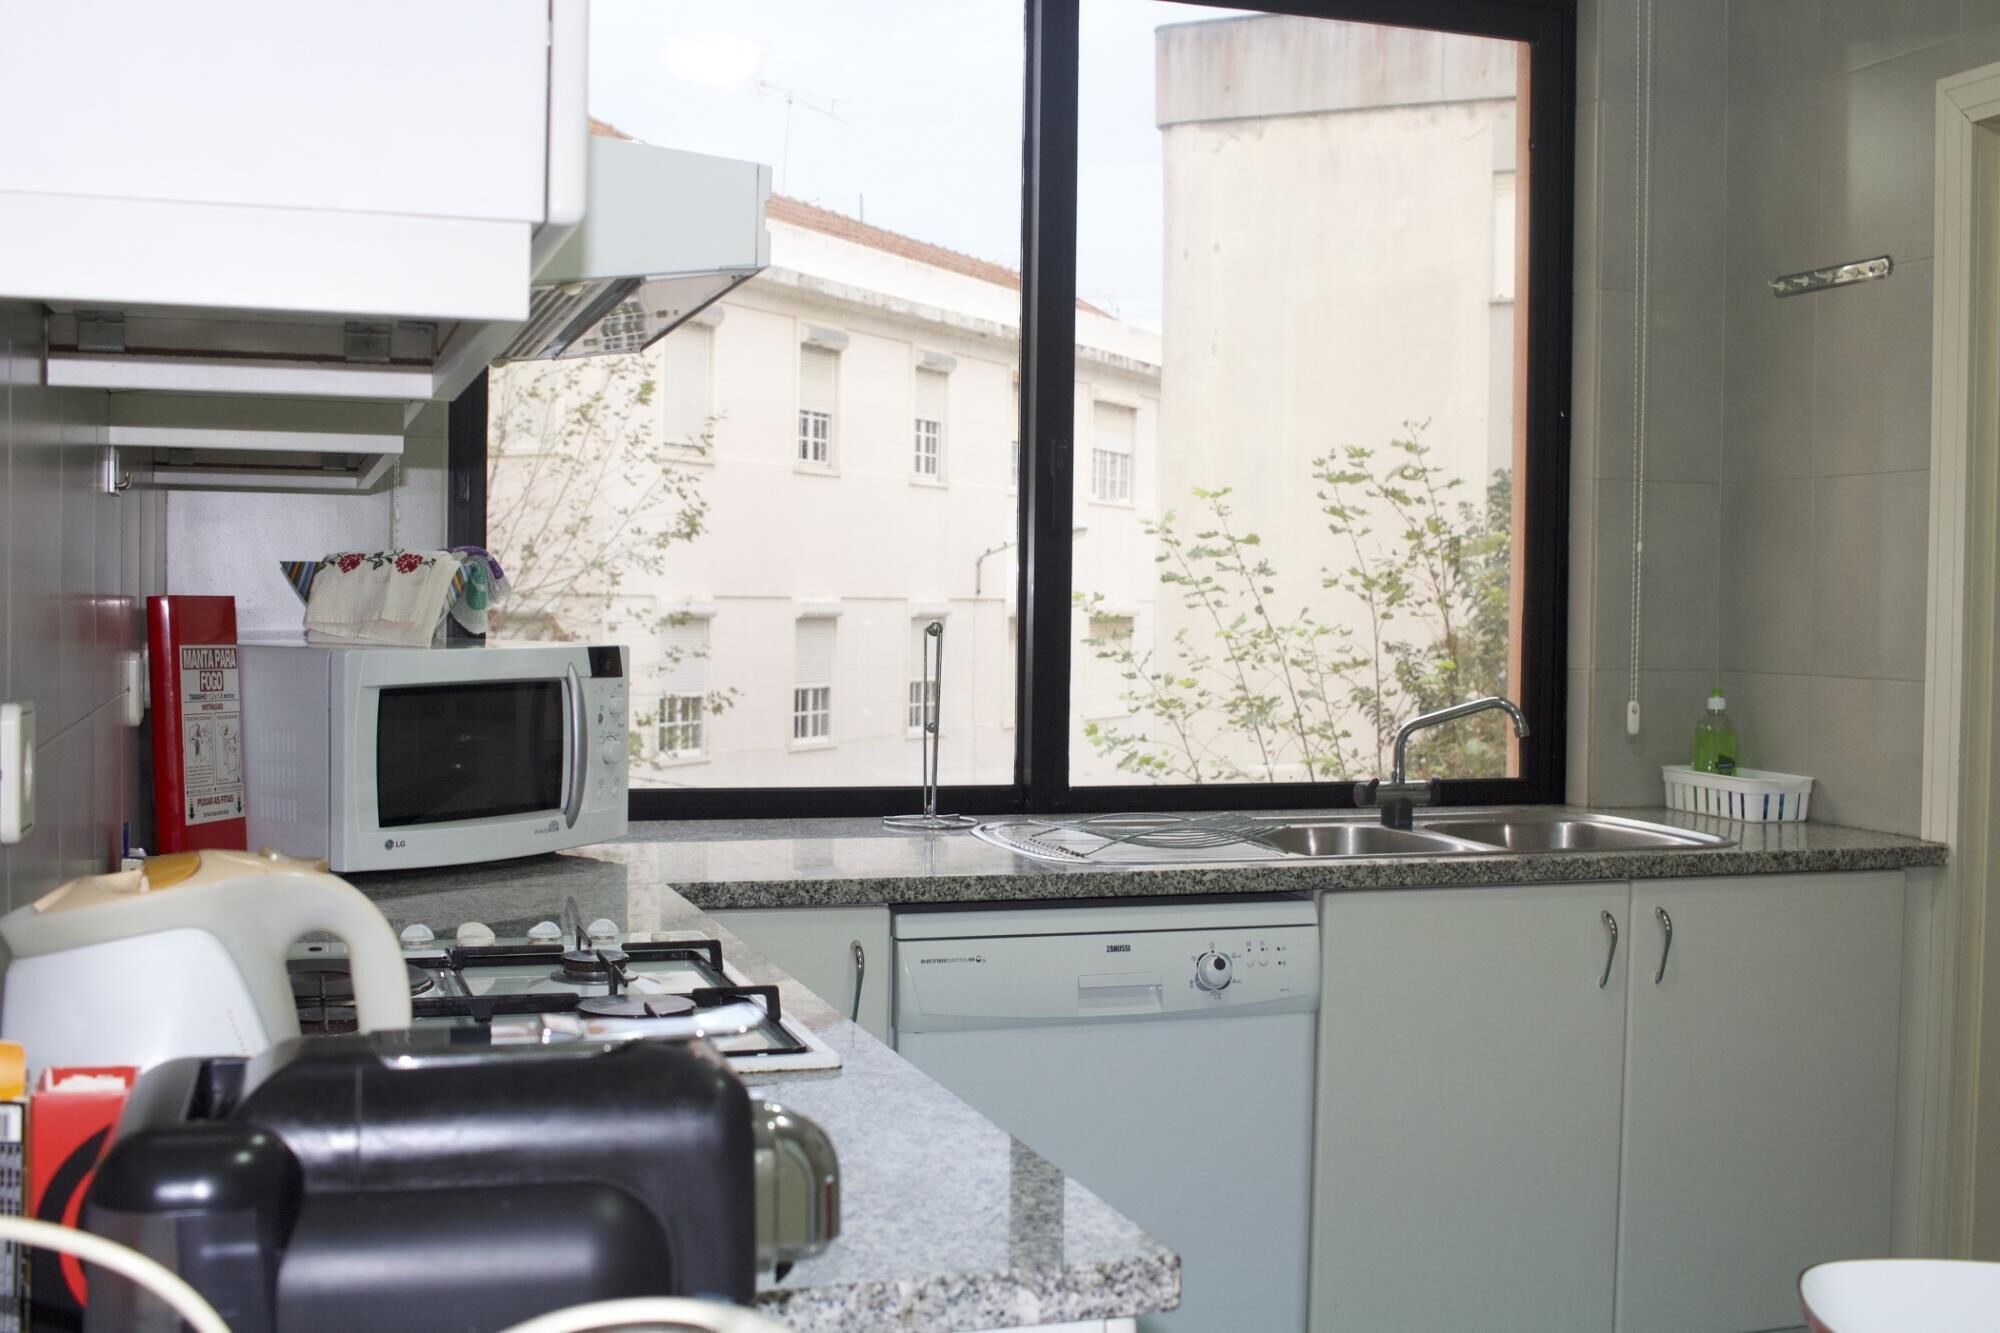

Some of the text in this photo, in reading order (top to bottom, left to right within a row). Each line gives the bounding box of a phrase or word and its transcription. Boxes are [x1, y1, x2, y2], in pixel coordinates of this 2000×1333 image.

[183, 648, 236, 669] MANTA PARA
[201, 671, 223, 690] FOGO
[395, 840, 406, 848] LG
[1105, 944, 1131, 953] ZANUSSI
